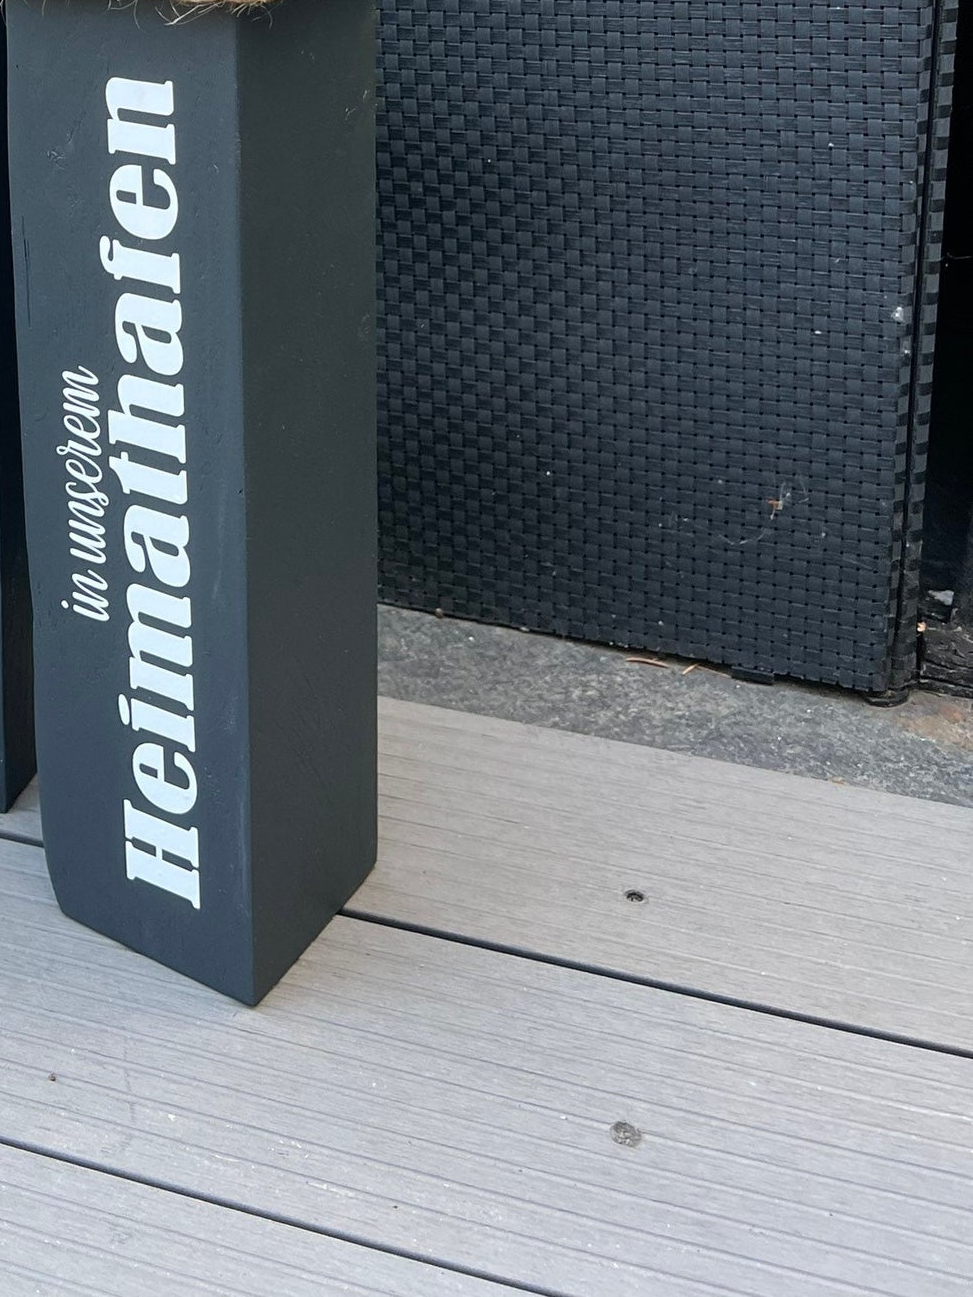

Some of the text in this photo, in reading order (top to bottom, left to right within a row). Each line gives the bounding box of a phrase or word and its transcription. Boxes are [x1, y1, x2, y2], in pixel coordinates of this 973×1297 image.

[55, 364, 111, 622] in unserem
[99, 76, 201, 910] Heimathafen
